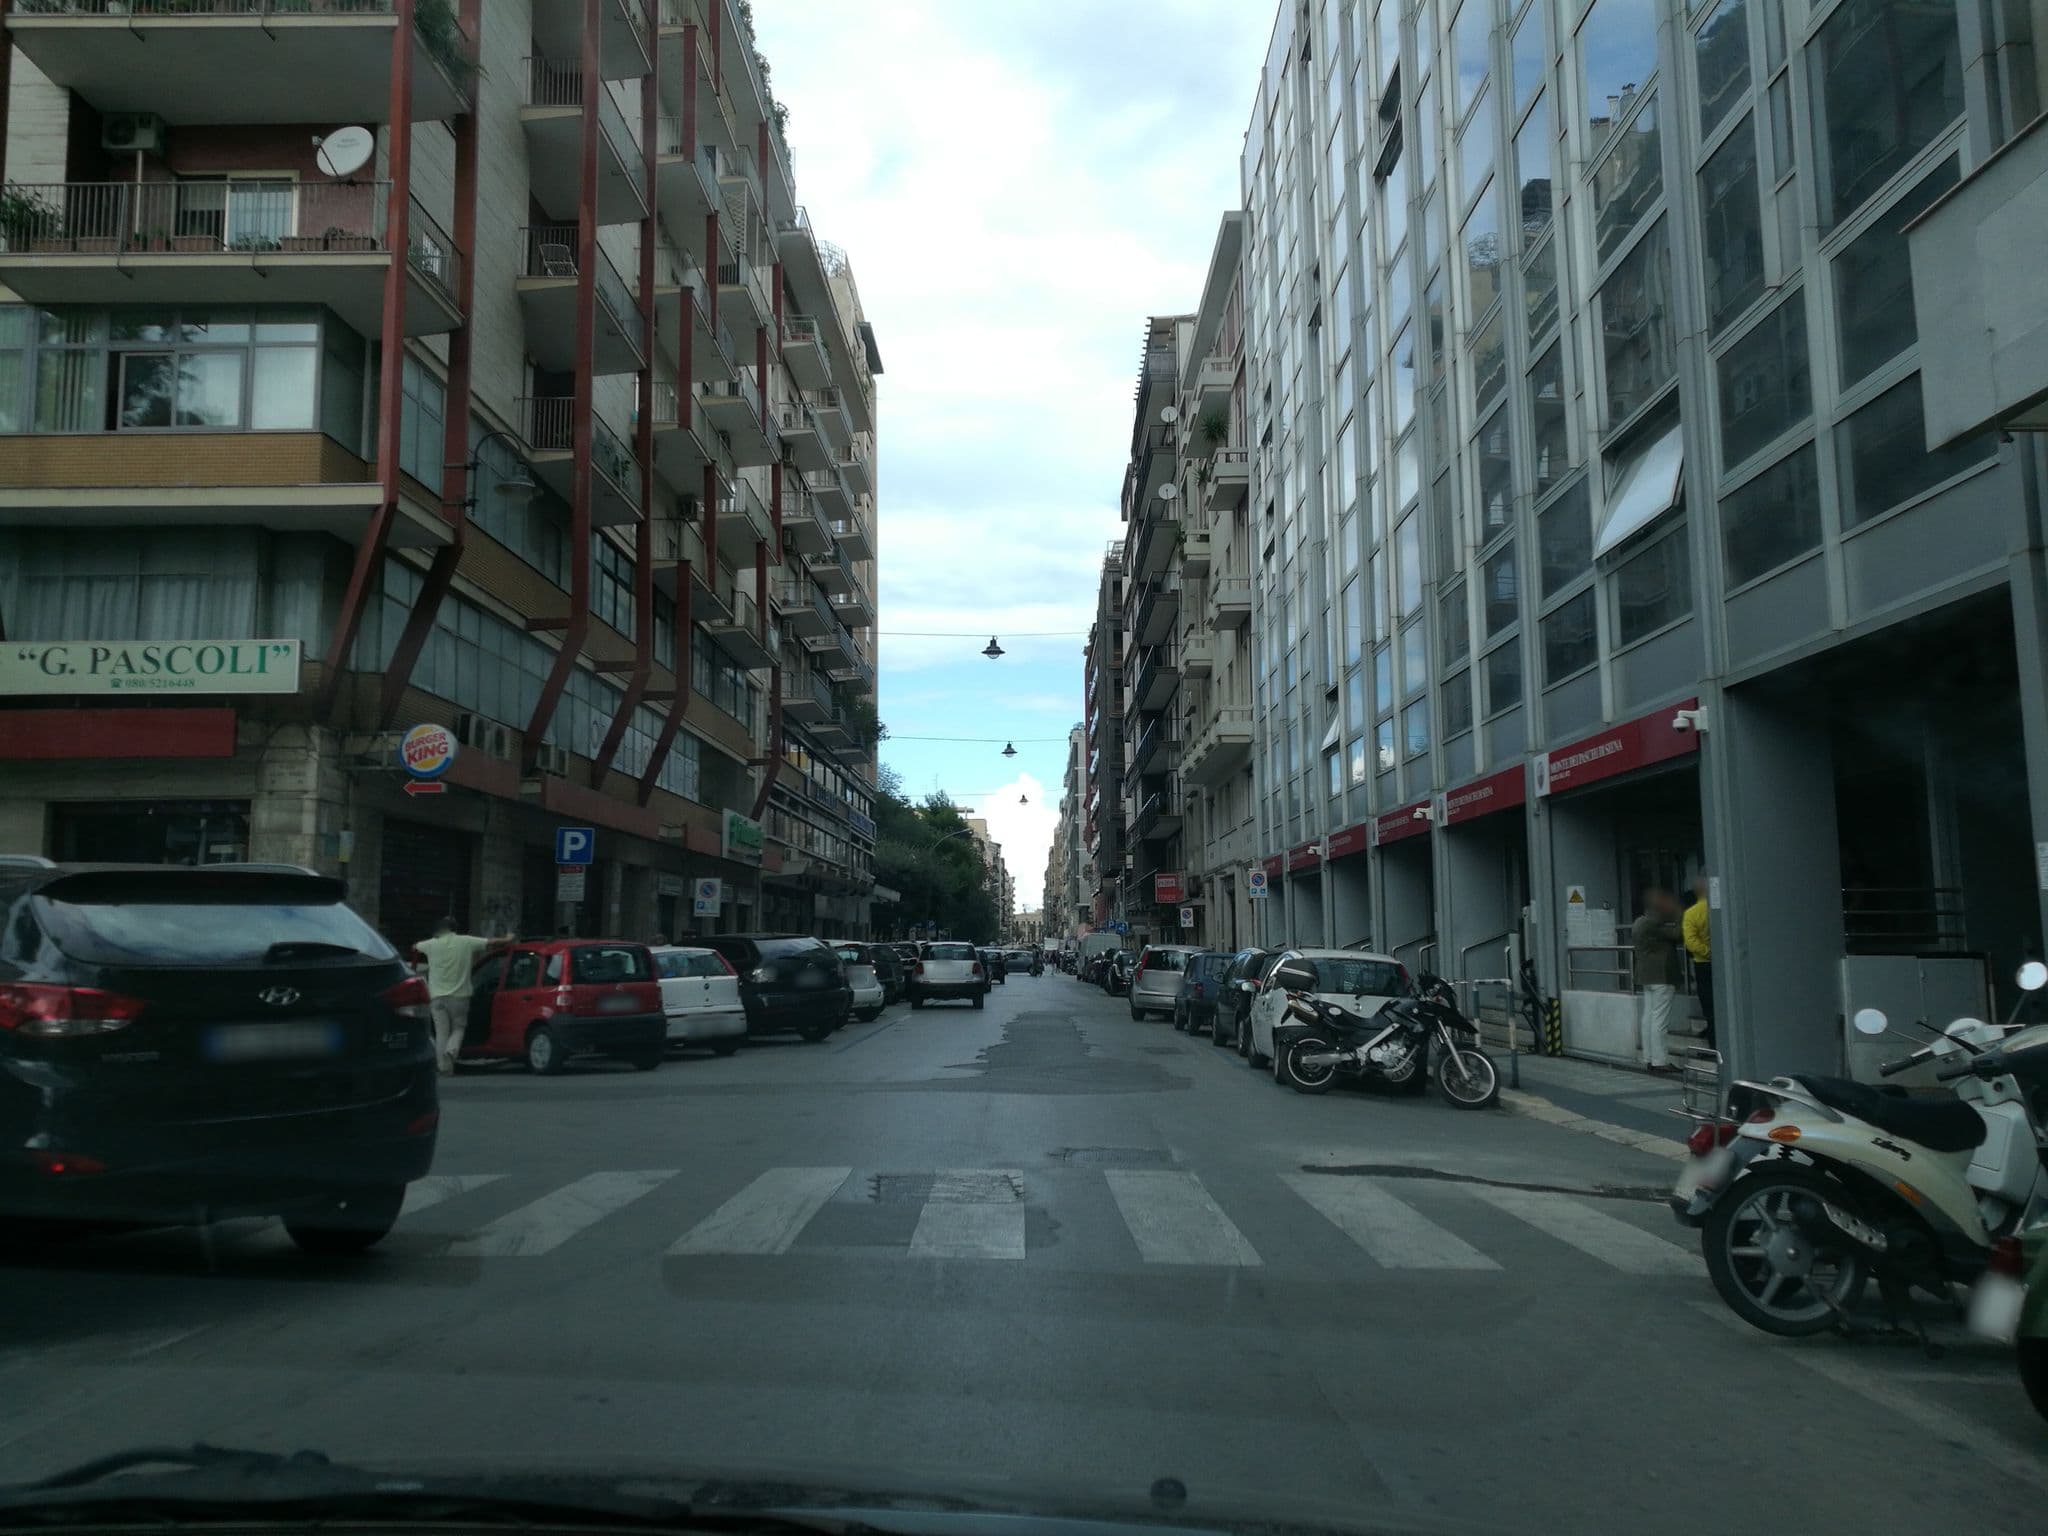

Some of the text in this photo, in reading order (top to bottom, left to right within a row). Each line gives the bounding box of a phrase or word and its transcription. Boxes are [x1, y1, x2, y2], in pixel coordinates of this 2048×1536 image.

[405, 732, 446, 752] BURGER
[407, 742, 449, 765] KING
[563, 831, 586, 860] P
